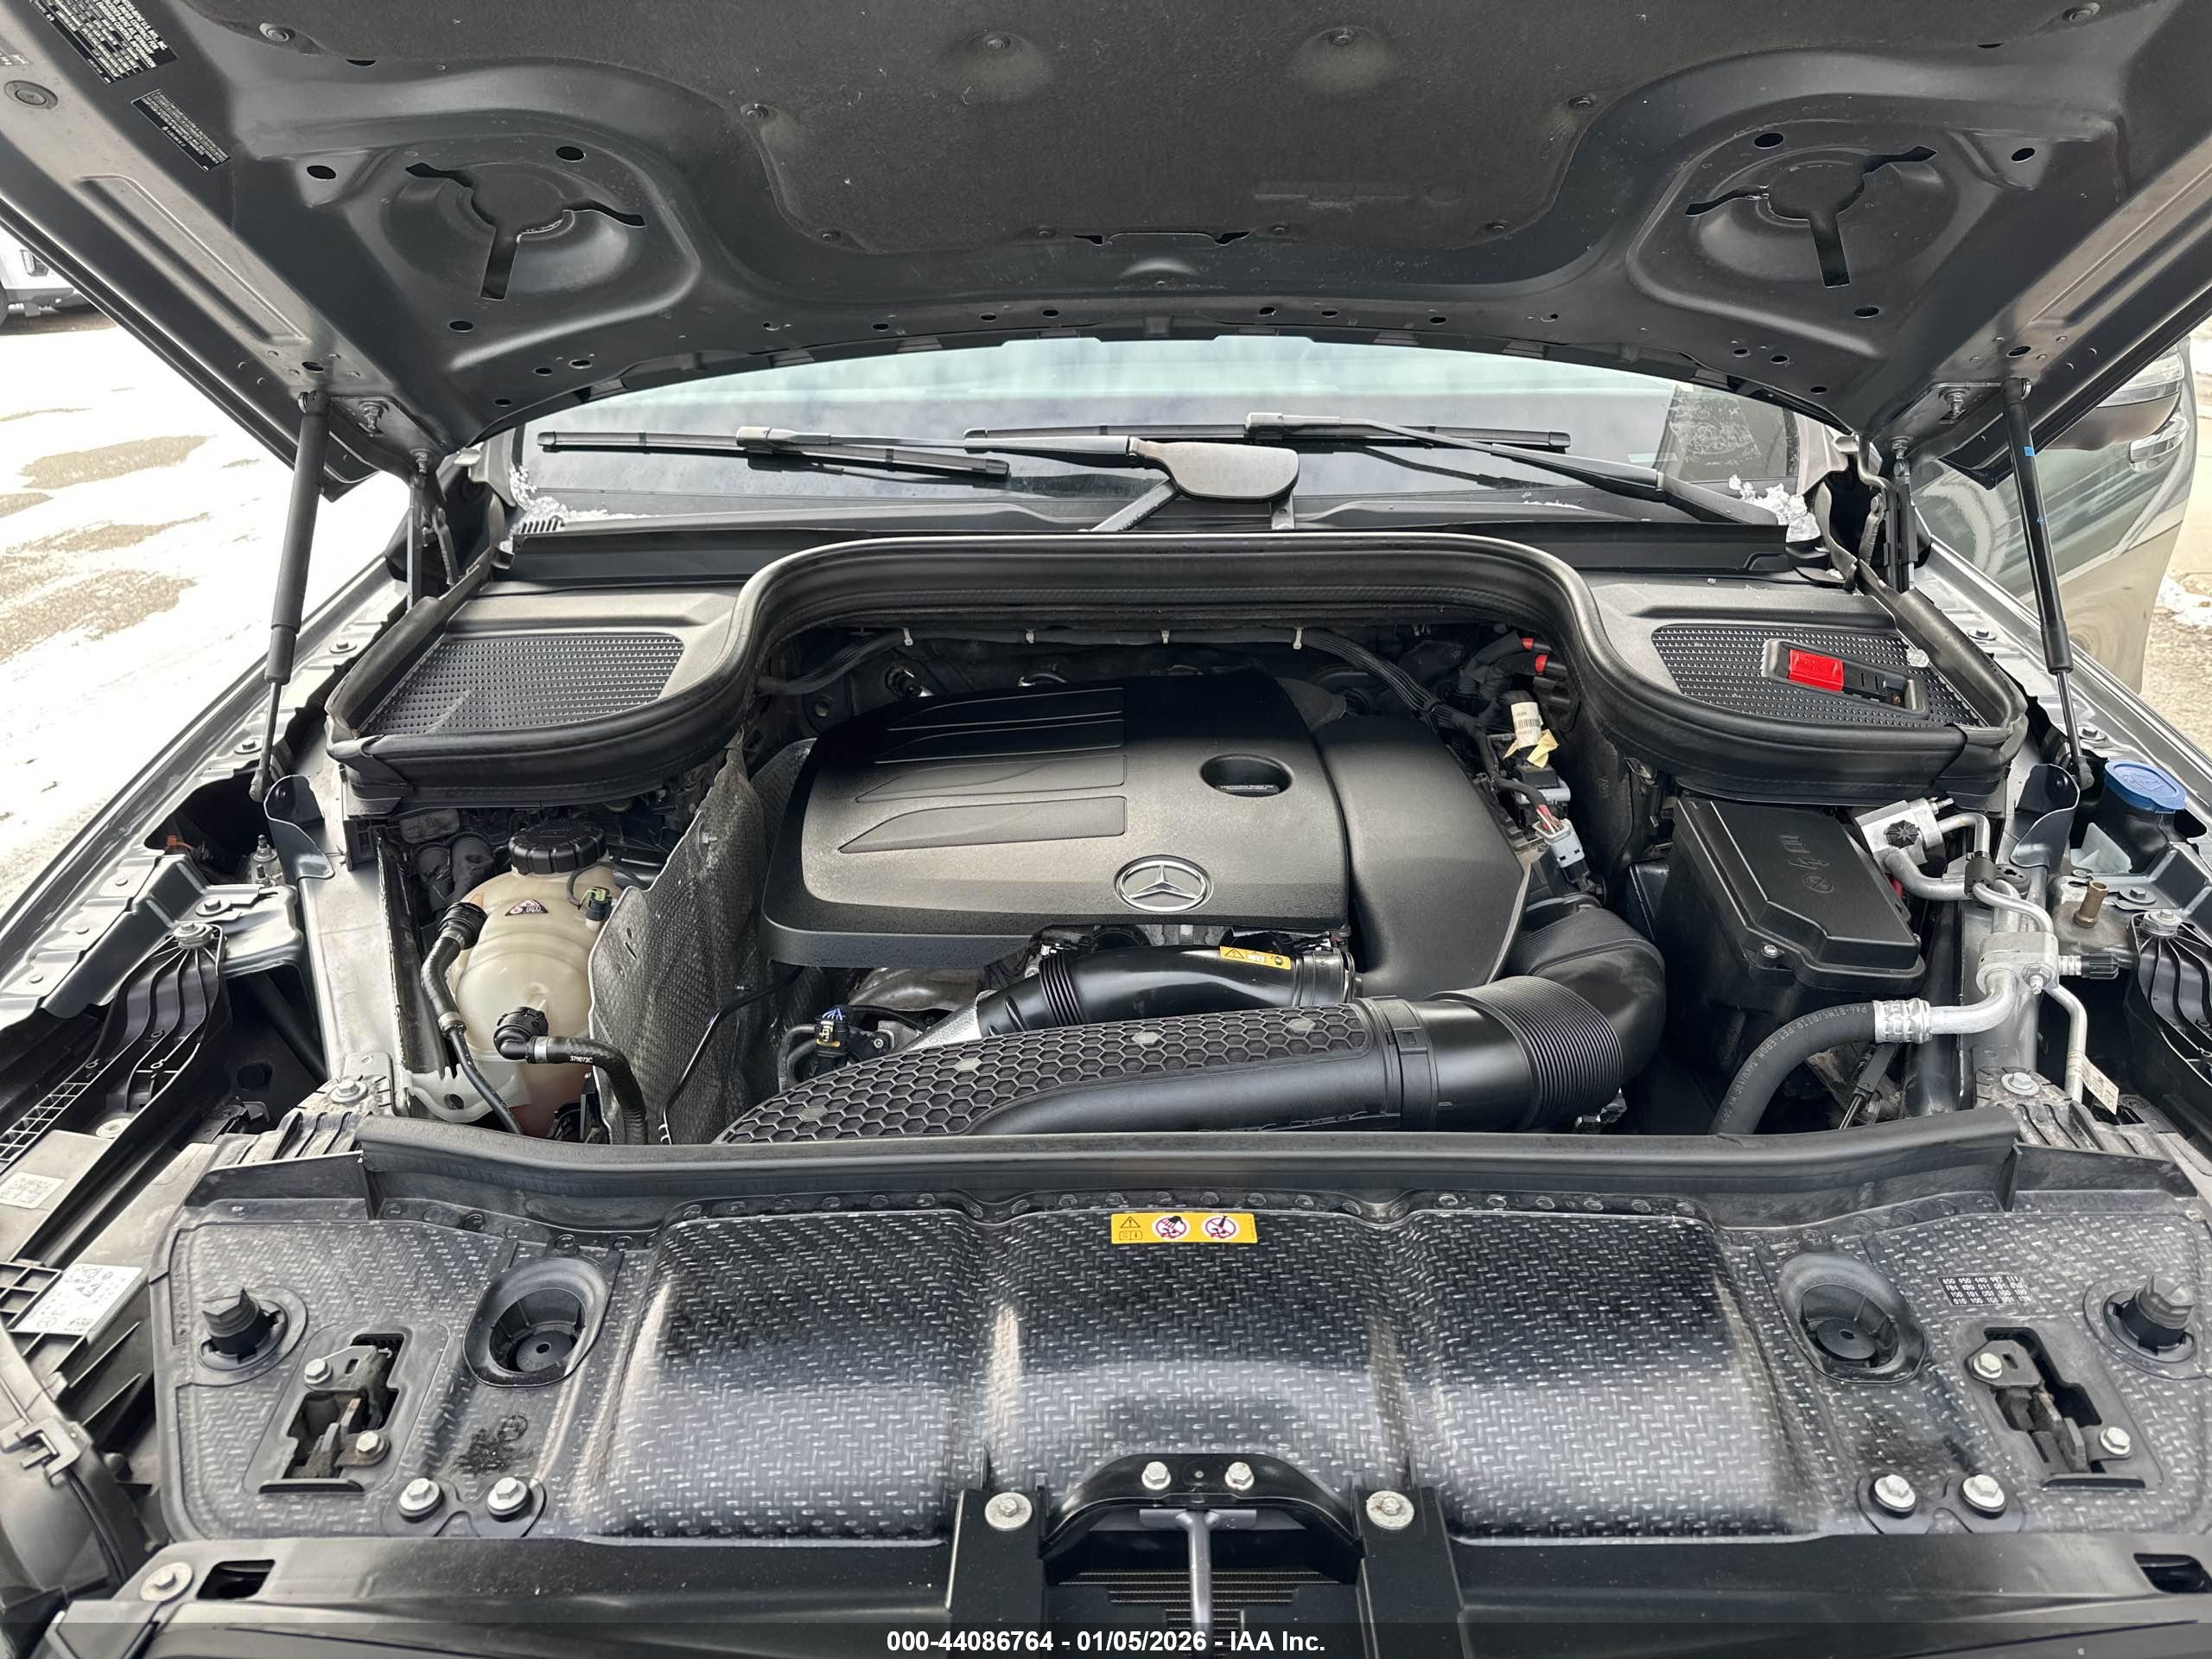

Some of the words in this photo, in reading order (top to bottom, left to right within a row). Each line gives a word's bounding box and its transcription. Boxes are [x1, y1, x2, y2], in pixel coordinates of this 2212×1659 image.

[95, 1, 118, 22] EMISSION
[113, 21, 133, 41] CONTROL
[130, 40, 157, 68] INFORMATION
[118, 4, 134, 20] UNDER
[130, 19, 153, 41] CONTRACT
[148, 40, 159, 50] FOR
[134, 34, 155, 54] GERMANY
